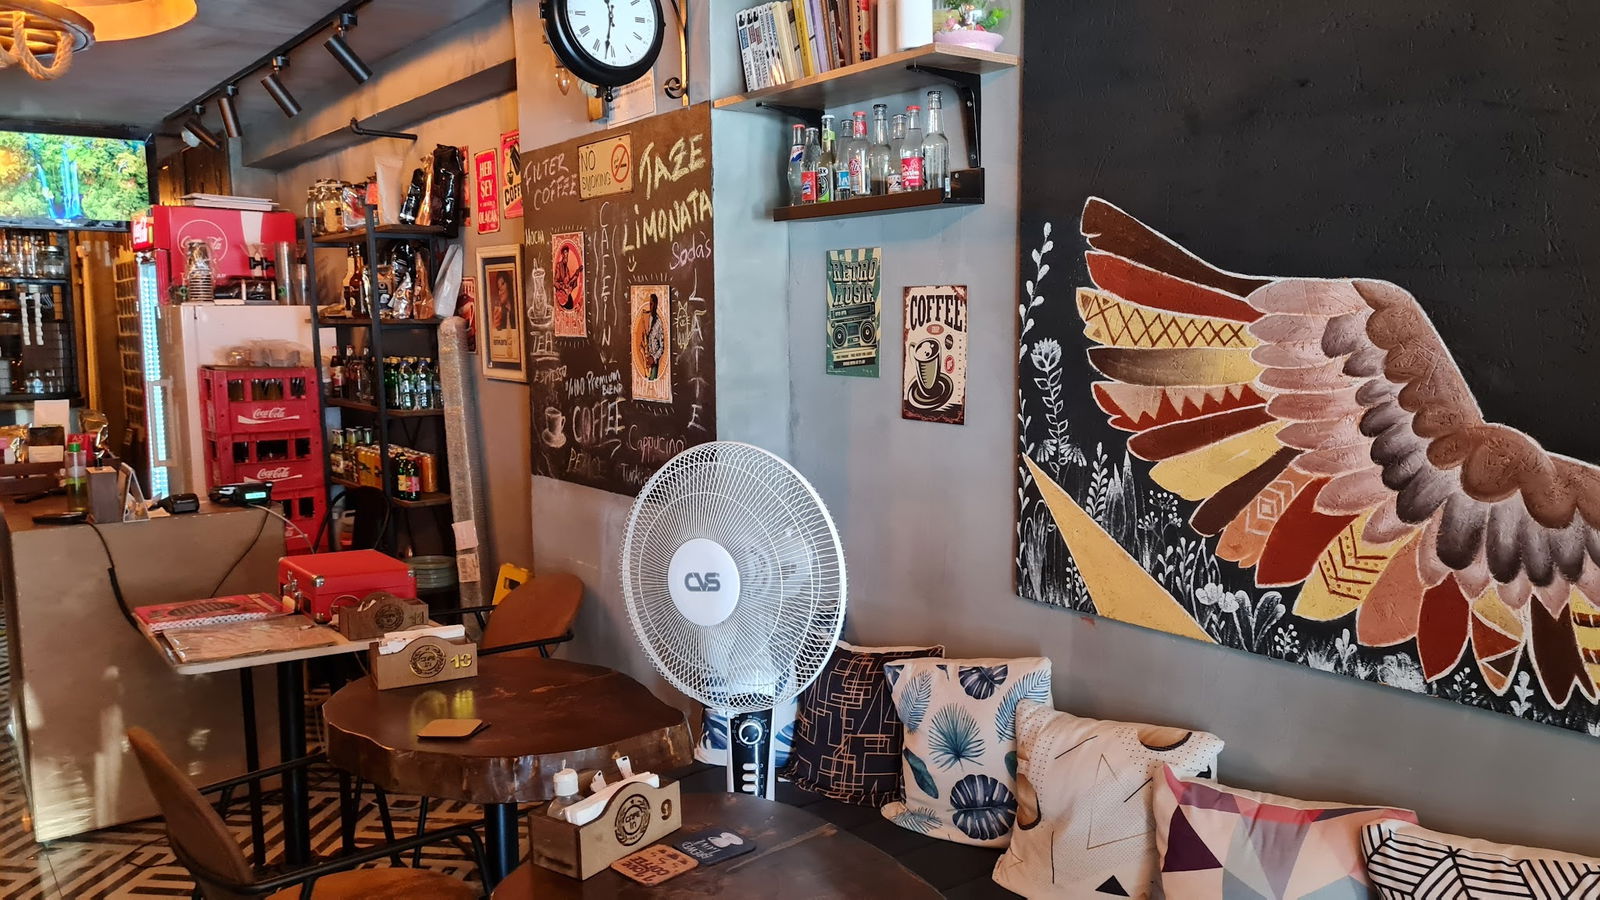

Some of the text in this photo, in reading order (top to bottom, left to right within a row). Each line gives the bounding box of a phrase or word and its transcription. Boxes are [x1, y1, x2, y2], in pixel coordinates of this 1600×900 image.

[523, 153, 569, 193] FILTER
[581, 150, 596, 172] NO
[639, 134, 706, 200] TAZE
[534, 174, 578, 210] COFFEE
[582, 171, 611, 191] SMOKING
[831, 258, 877, 283] RETRO
[833, 282, 875, 307] MUSIC
[530, 330, 554, 353] TEA
[572, 396, 627, 443] COFFEE
[684, 572, 721, 592] CVS
[661, 798, 673, 821] 9
